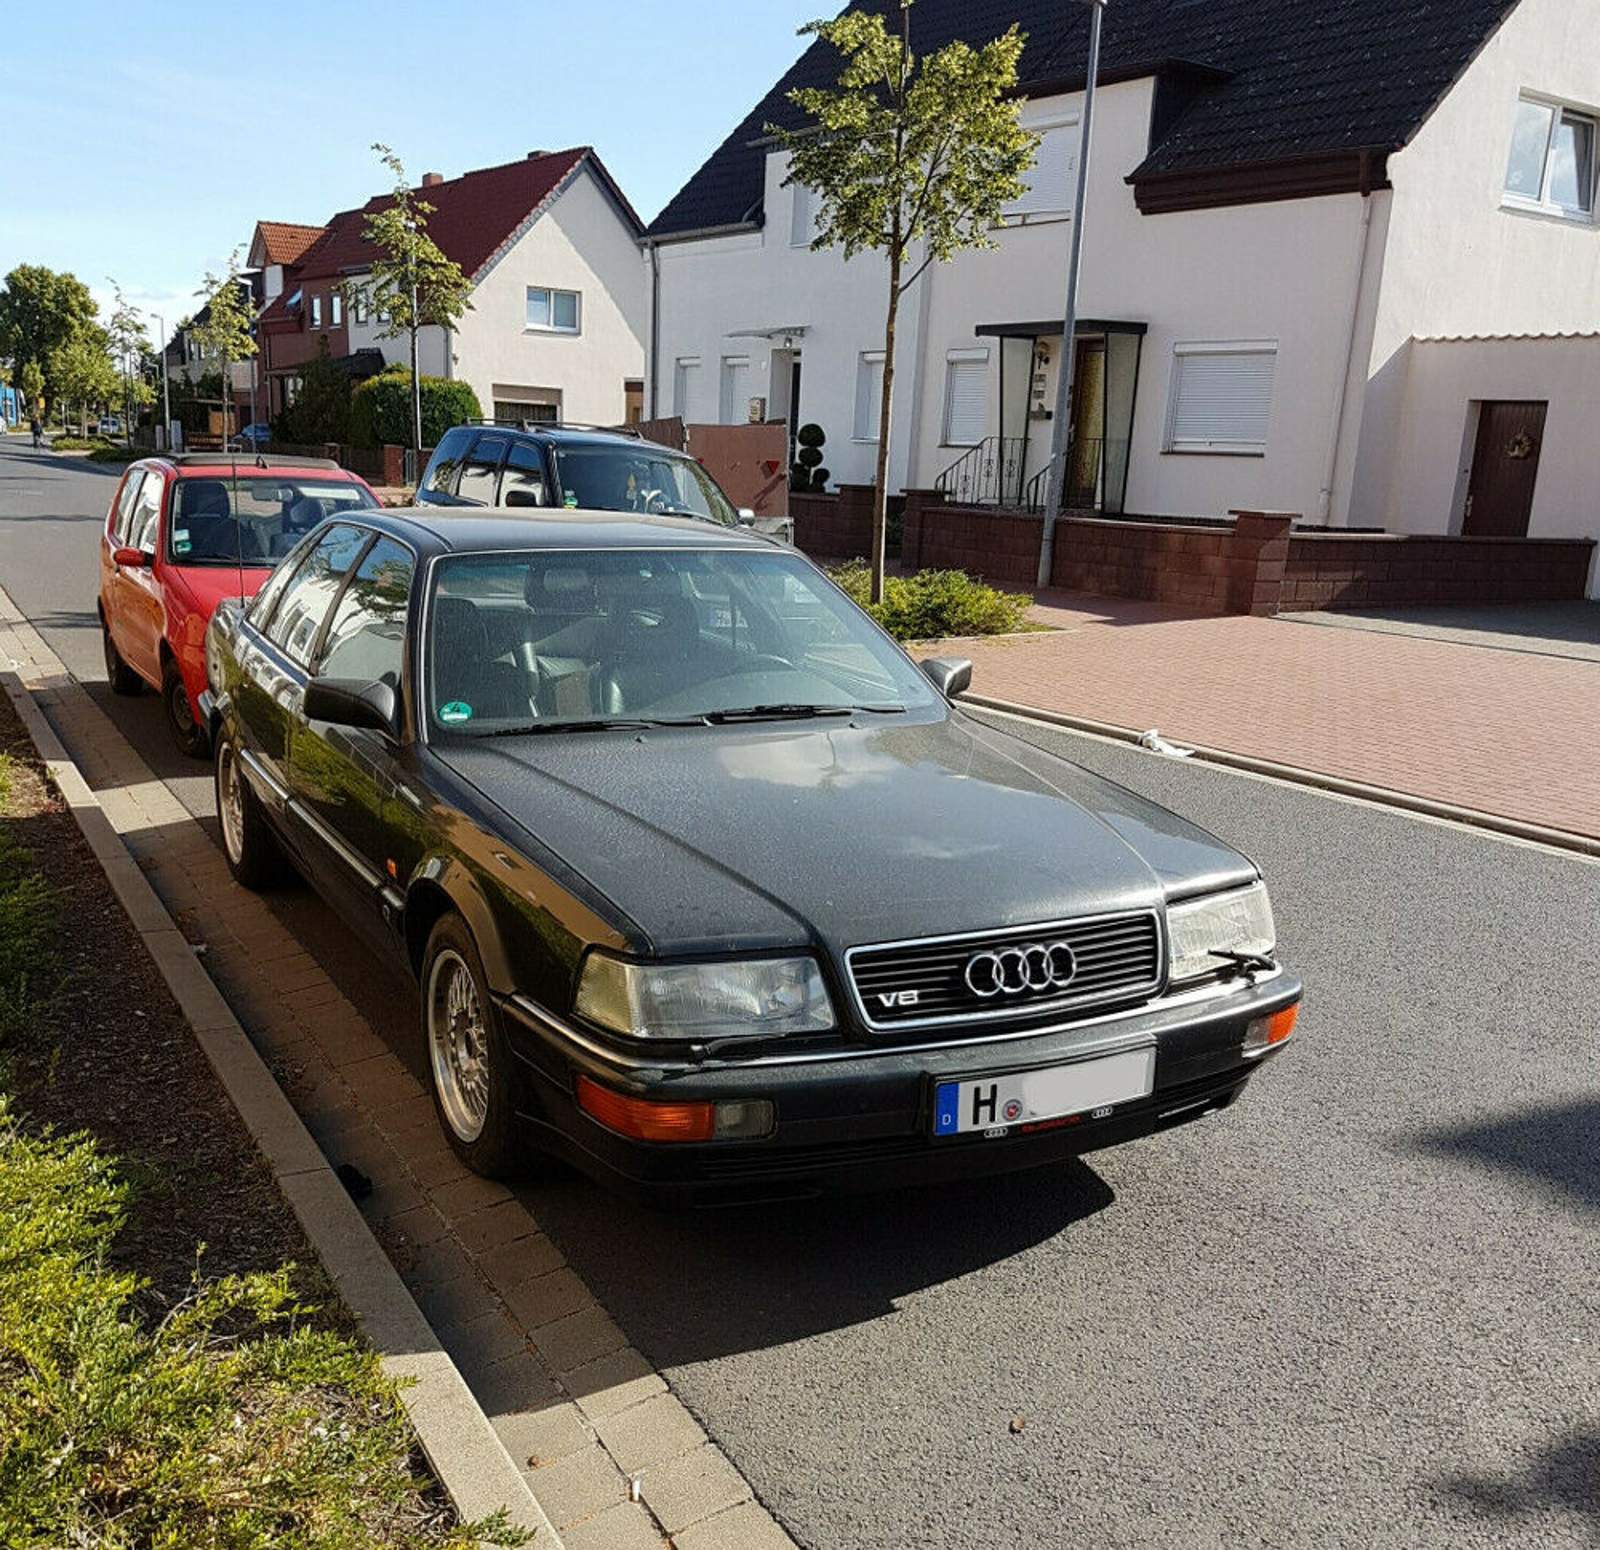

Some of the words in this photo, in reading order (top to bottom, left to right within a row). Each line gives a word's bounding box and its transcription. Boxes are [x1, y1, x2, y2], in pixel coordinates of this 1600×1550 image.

[877, 990, 919, 1007] V8
[972, 1084, 998, 1125] H
[942, 1113, 952, 1126] D
